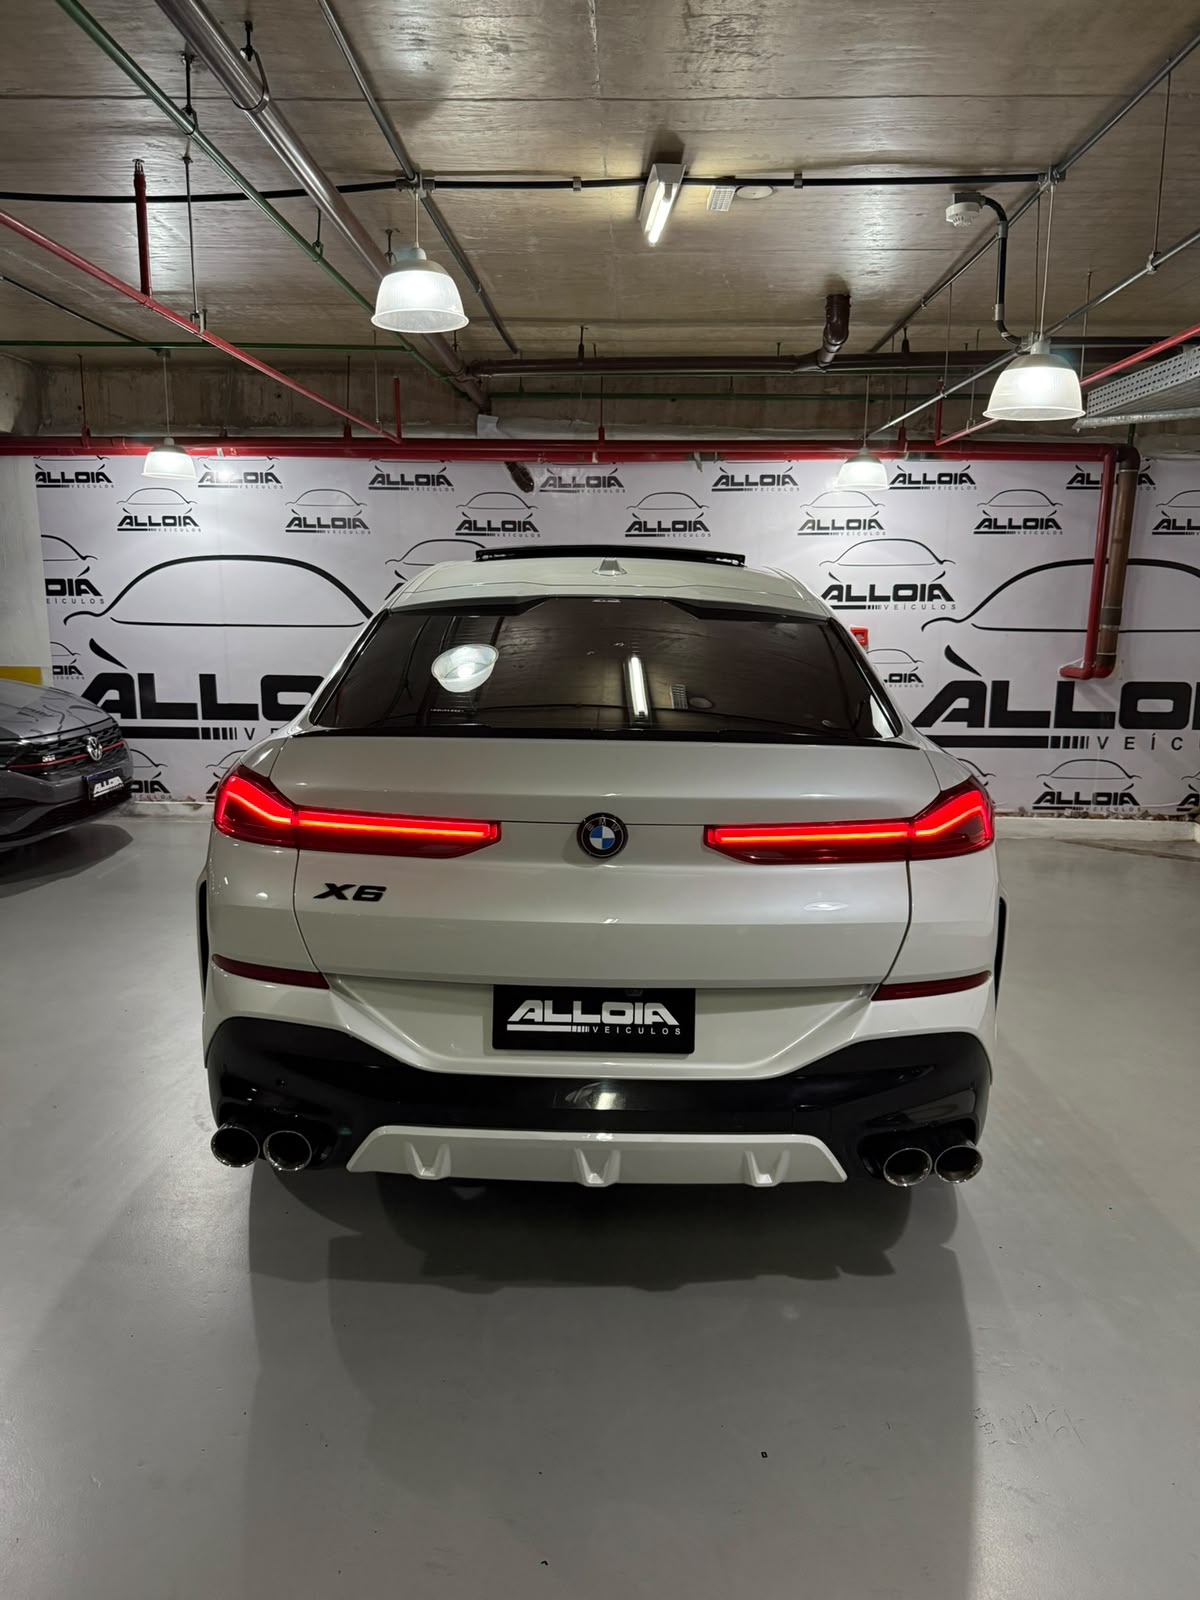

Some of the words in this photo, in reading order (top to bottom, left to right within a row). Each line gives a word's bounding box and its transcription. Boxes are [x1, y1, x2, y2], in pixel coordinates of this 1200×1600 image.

[368, 473, 454, 487] ALLOIA
[540, 475, 624, 488] ALLOIA
[711, 474, 799, 487] ALLOIA
[889, 472, 976, 485] ALLOIA
[117, 515, 200, 527] ALLOIA
[285, 516, 370, 529] ALLOIA
[455, 519, 540, 532] ALLOIA
[625, 520, 710, 532] ALLOIA
[798, 518, 885, 531] ALLOIA
[974, 517, 1062, 530] ALLOIA
[821, 583, 956, 602] ALLOIA
[1032, 791, 1141, 806] ALLOIA
[313, 882, 388, 902] X6
[507, 1000, 680, 1026] ALLOIA
[592, 1026, 681, 1036] VEICULOS
